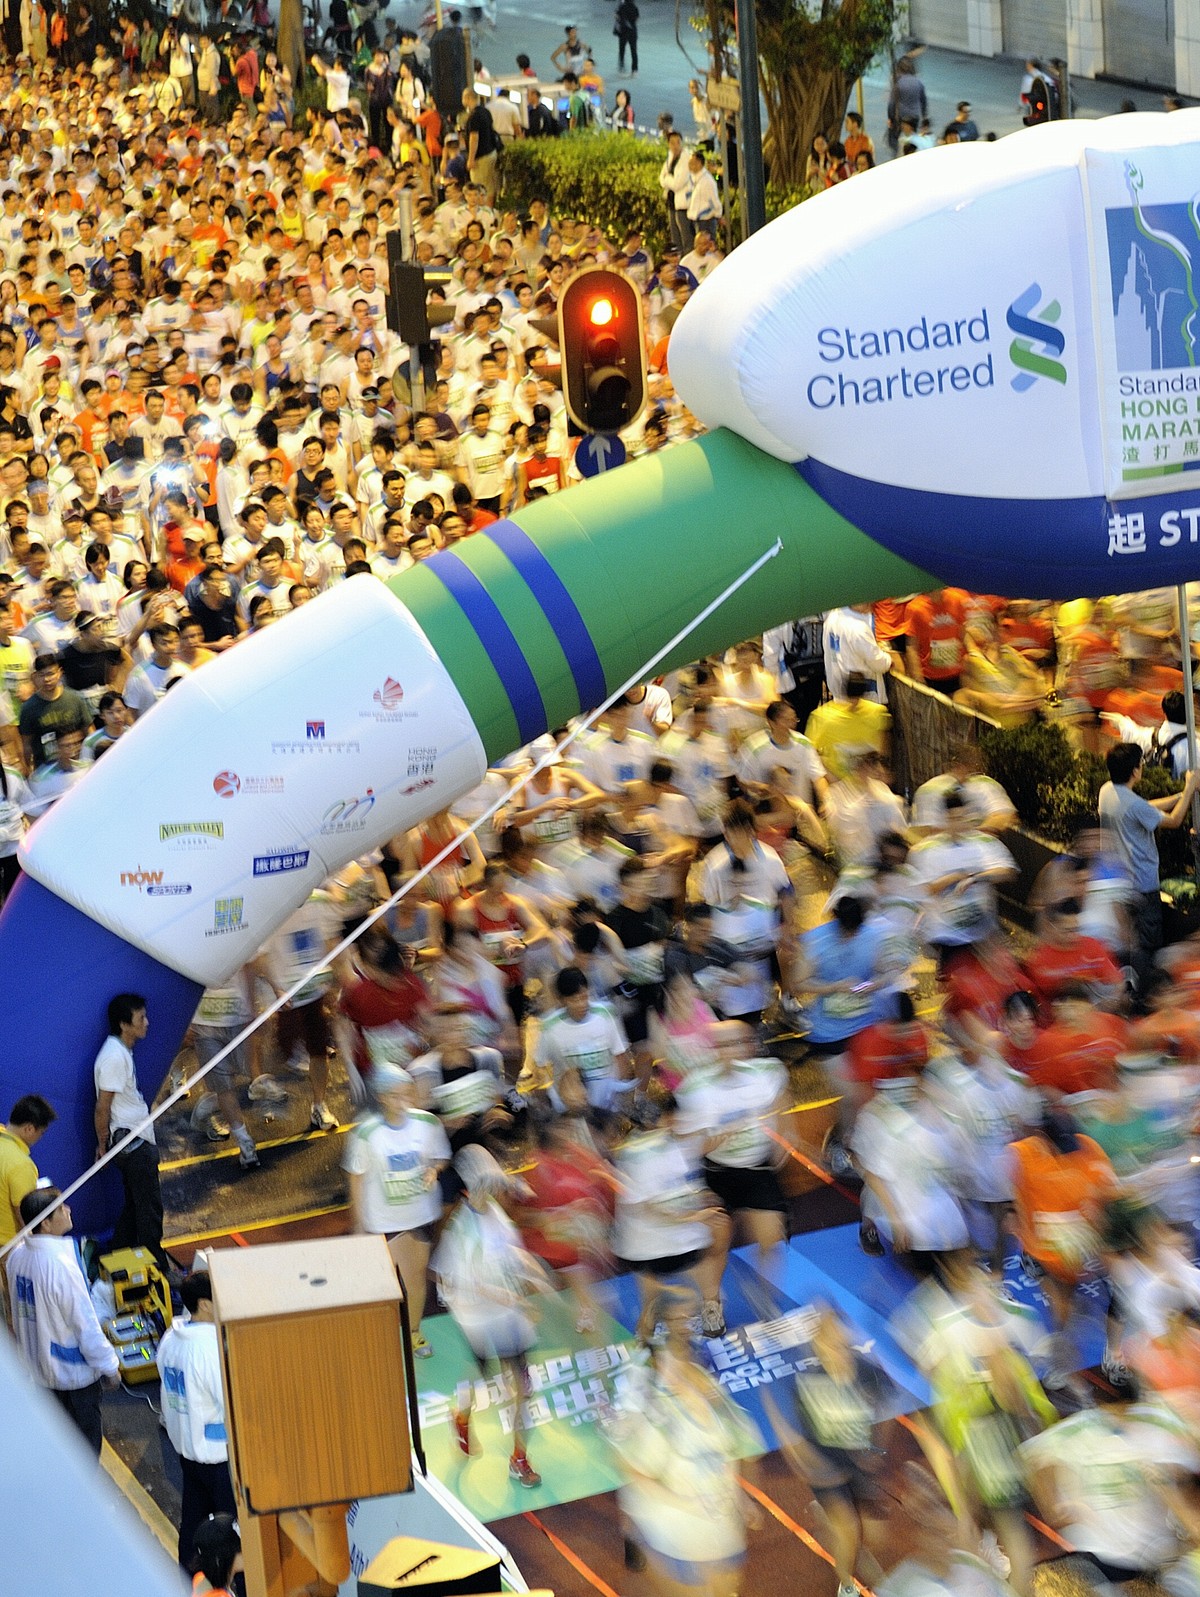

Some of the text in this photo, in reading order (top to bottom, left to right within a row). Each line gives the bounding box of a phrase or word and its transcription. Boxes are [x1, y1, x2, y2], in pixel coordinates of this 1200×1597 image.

[817, 308, 989, 364] Standard
[806, 355, 995, 410] Chartered
[1120, 396, 1188, 419] HONG
[1107, 511, 1147, 557] 起
[162, 822, 222, 840] NATURE VALLEY
[120, 867, 165, 889] now
